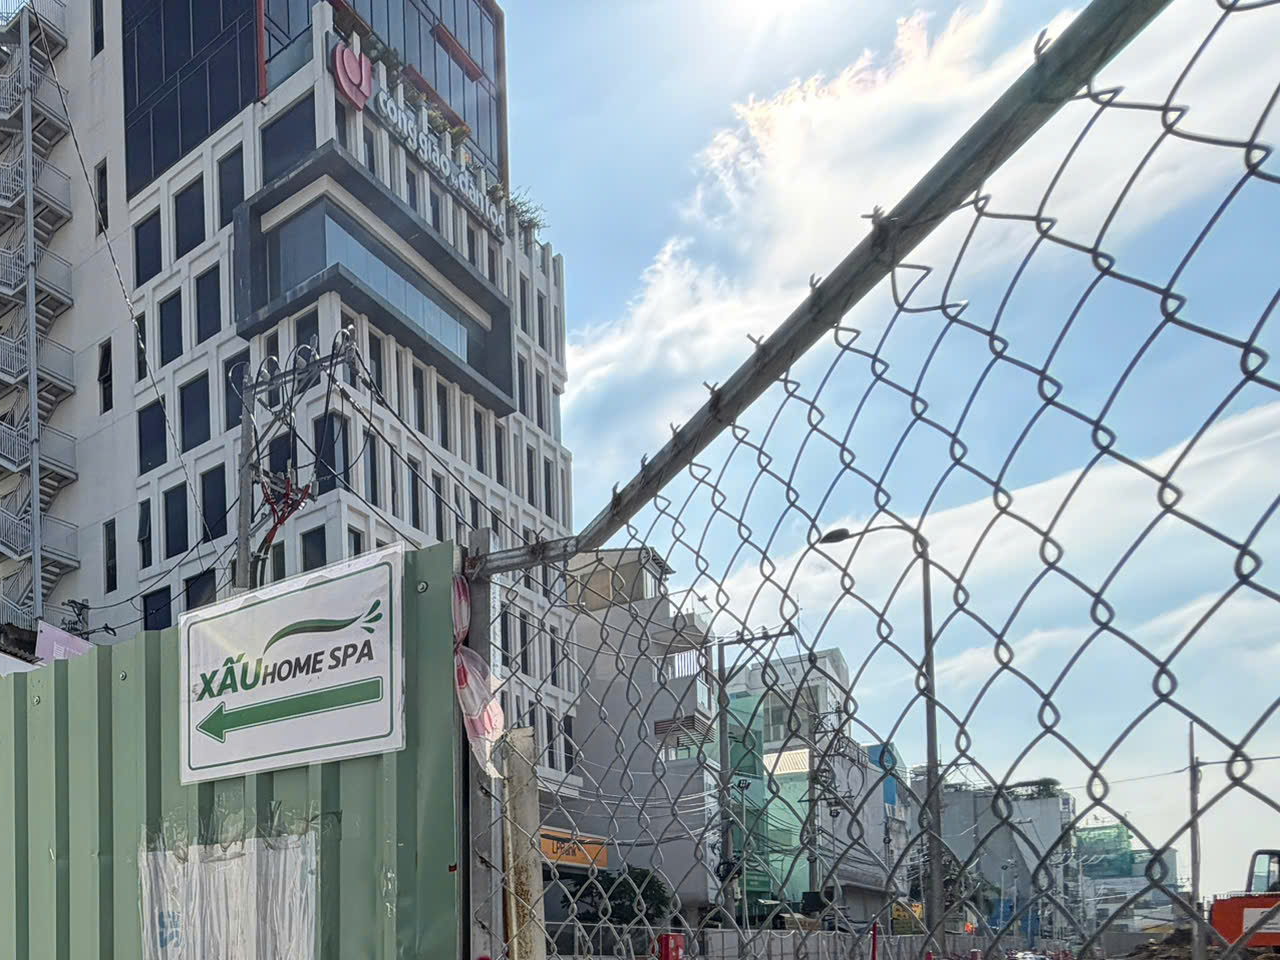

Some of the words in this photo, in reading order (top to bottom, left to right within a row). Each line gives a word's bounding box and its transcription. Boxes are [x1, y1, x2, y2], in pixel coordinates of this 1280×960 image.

[196, 652, 263, 702] XẤU
[262, 651, 325, 686] HOME
[327, 639, 374, 670] SPA
